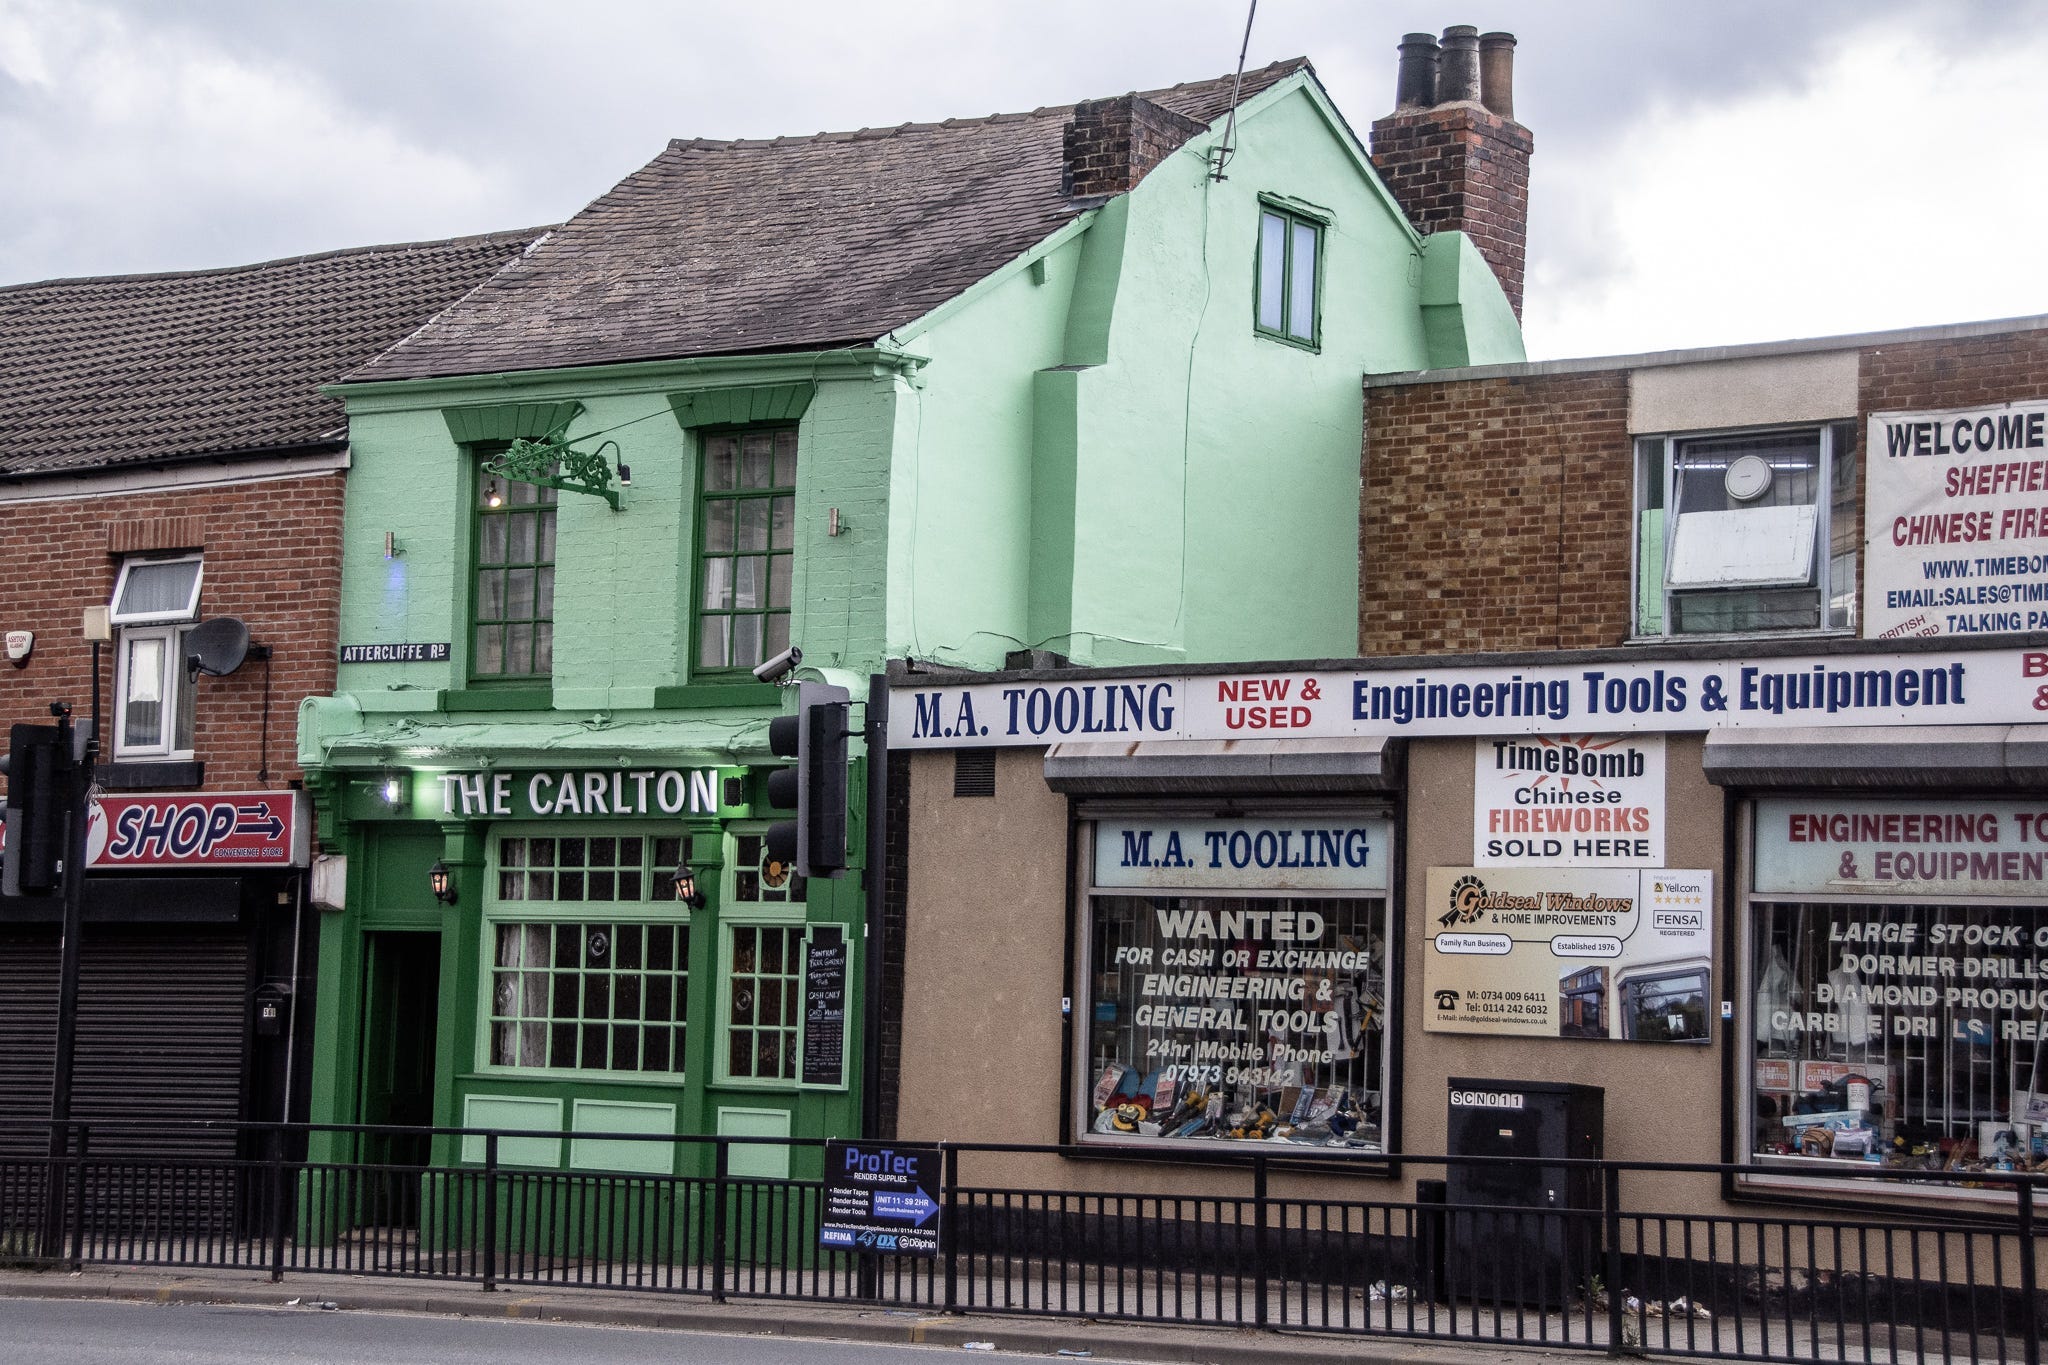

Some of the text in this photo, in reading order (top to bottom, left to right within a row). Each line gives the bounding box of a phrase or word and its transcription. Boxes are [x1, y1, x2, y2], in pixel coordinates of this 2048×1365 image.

[1886, 412, 2045, 458] WELCOME
[1892, 511, 1994, 547] CHINESE
[1946, 613, 2021, 632] TALKING
[344, 645, 423, 661] ATTERCLIFFE
[1218, 678, 1322, 702] NEW &
[1352, 661, 1965, 723] Engineering Tools & Equipment
[912, 682, 1175, 738] M.A. TOOLING
[1225, 706, 1312, 729] USED
[1493, 742, 1645, 778] TimeBomb
[437, 768, 718, 816] THE CARLTON
[1514, 787, 1622, 805] Chinese
[1489, 807, 1650, 833] FIREWORKS
[1788, 813, 1998, 843] ENGINEERING
[109, 803, 238, 859] SHOP
[214, 847, 283, 858] CONVENIENCE STORE
[1121, 828, 1370, 869] M.A. TOOLING
[1487, 839, 1649, 857] SOLD HERE
[1838, 850, 2048, 881] & EQUIPMEN
[1664, 883, 1700, 892] Yell.com
[1456, 886, 1634, 920] Goldseal Windows
[1157, 909, 1325, 941] WANTED
[1491, 913, 1616, 926] & HOME IMPROVEMENTS
[1656, 914, 1699, 925] FENSA
[1440, 939, 1461, 949] Family
[1477, 940, 1506, 948] Business
[1828, 922, 1917, 943] LARGE
[1929, 924, 2022, 946] STOCK
[1557, 942, 1615, 951] Established 1976
[1114, 946, 1370, 970] FOR CASH OR EXCHANGE
[1842, 954, 1956, 977] DORMER
[808, 991, 824, 1000] CASH
[1141, 973, 1333, 1002] ENGINEERING &
[1467, 991, 1546, 1002] M: 0734 009 6411
[1817, 983, 1938, 1006] DIAMOND
[1135, 1004, 1339, 1034] GENERAL TOOLS
[1465, 1003, 1548, 1014] Tel: 0114 242 6032
[1458, 1015, 1548, 1025] info@goldseal-windows.co.uk
[1771, 1010, 1882, 1035] CARBIE
[1146, 1038, 1333, 1063] 24hr Mobile Phone
[1166, 1064, 1221, 1083] 07973
[1452, 1092, 1522, 1107] SCN011
[845, 1147, 918, 1174] ProTec
[853, 1172, 908, 1183] RENDER SUPPLIES
[832, 1197, 852, 1205] Render
[833, 1187, 869, 1196] Render Tapes
[875, 1195, 891, 1203] UNIT
[904, 1197, 914, 1206] S9
[914, 1198, 929, 1207] 2HR
[832, 1206, 866, 1216] Render Tools
[824, 1231, 852, 1241] REFINA
[877, 1234, 898, 1246] OX
[909, 1236, 936, 1249] Dolphin
